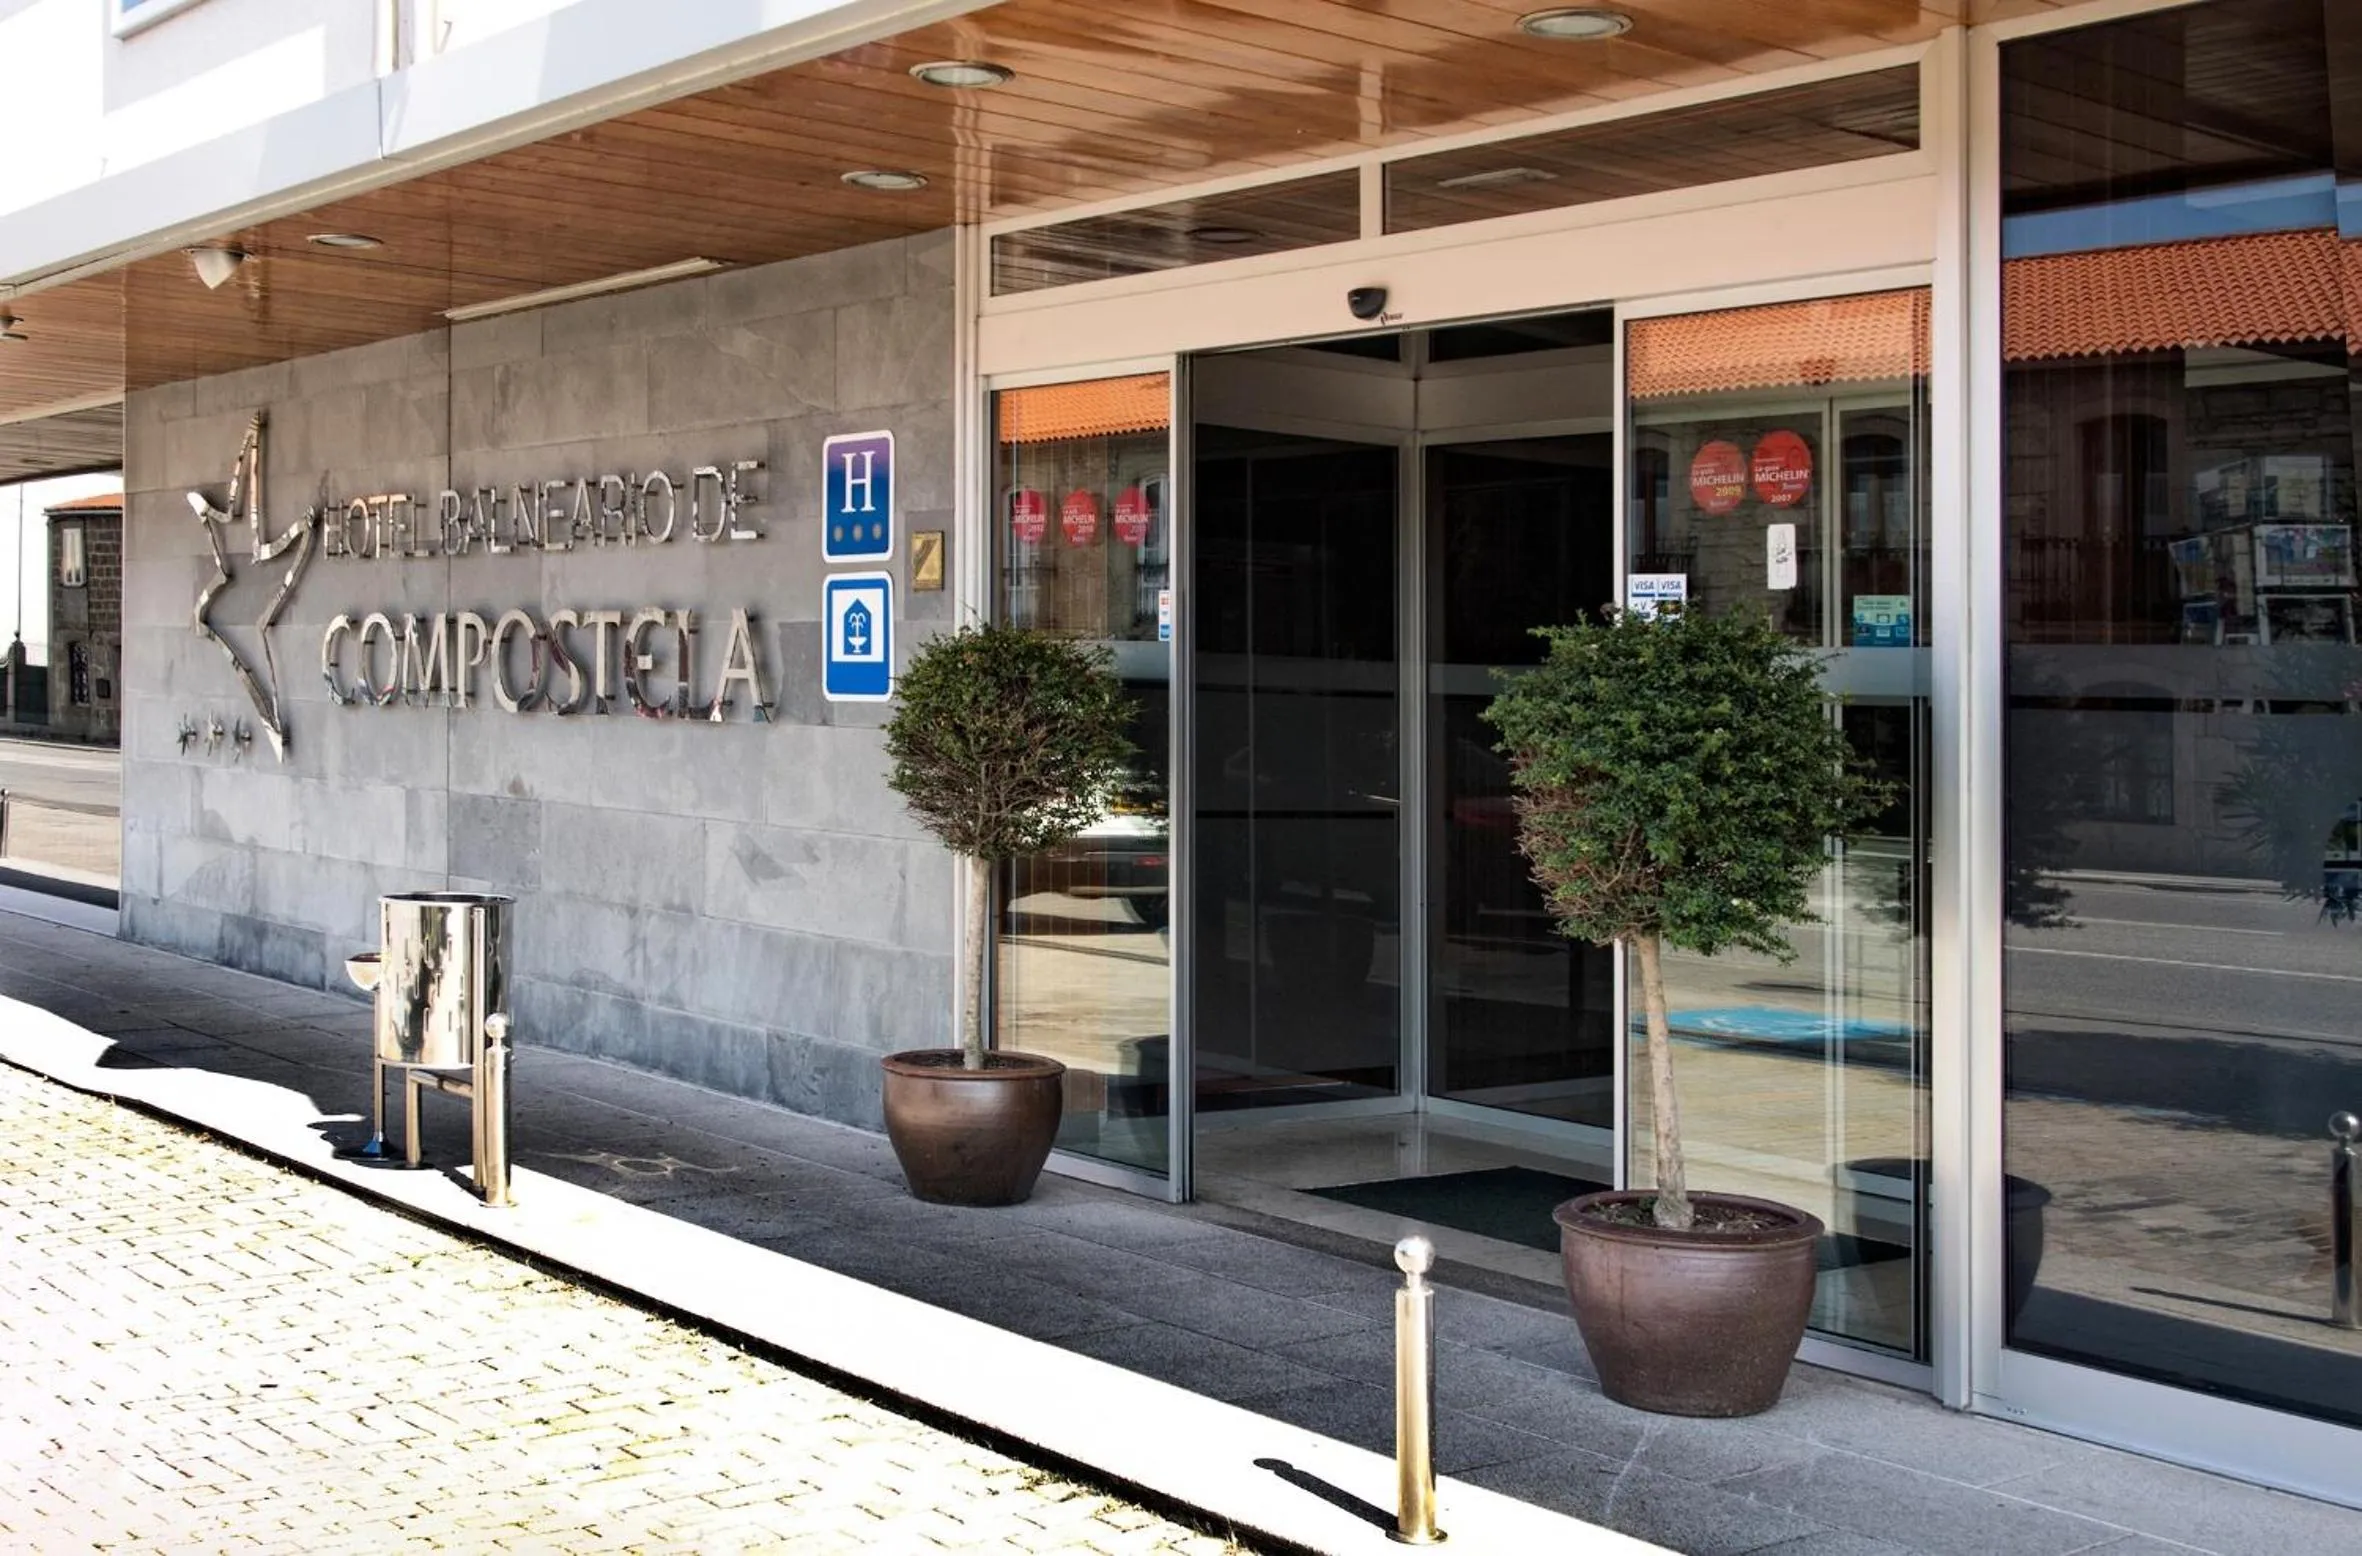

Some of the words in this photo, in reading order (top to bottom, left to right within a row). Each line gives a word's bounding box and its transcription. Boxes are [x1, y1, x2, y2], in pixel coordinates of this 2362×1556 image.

[841, 451, 876, 513] H
[1692, 472, 1744, 486] MICHELIN
[1755, 470, 1809, 483] MICHELIN
[324, 493, 430, 559] HOTEL
[440, 469, 676, 556] BALNEARIO
[692, 460, 759, 541] DE
[1634, 581, 1654, 590] VISA
[1660, 581, 1681, 590] VISA
[322, 606, 775, 723] COMPOSTELA
